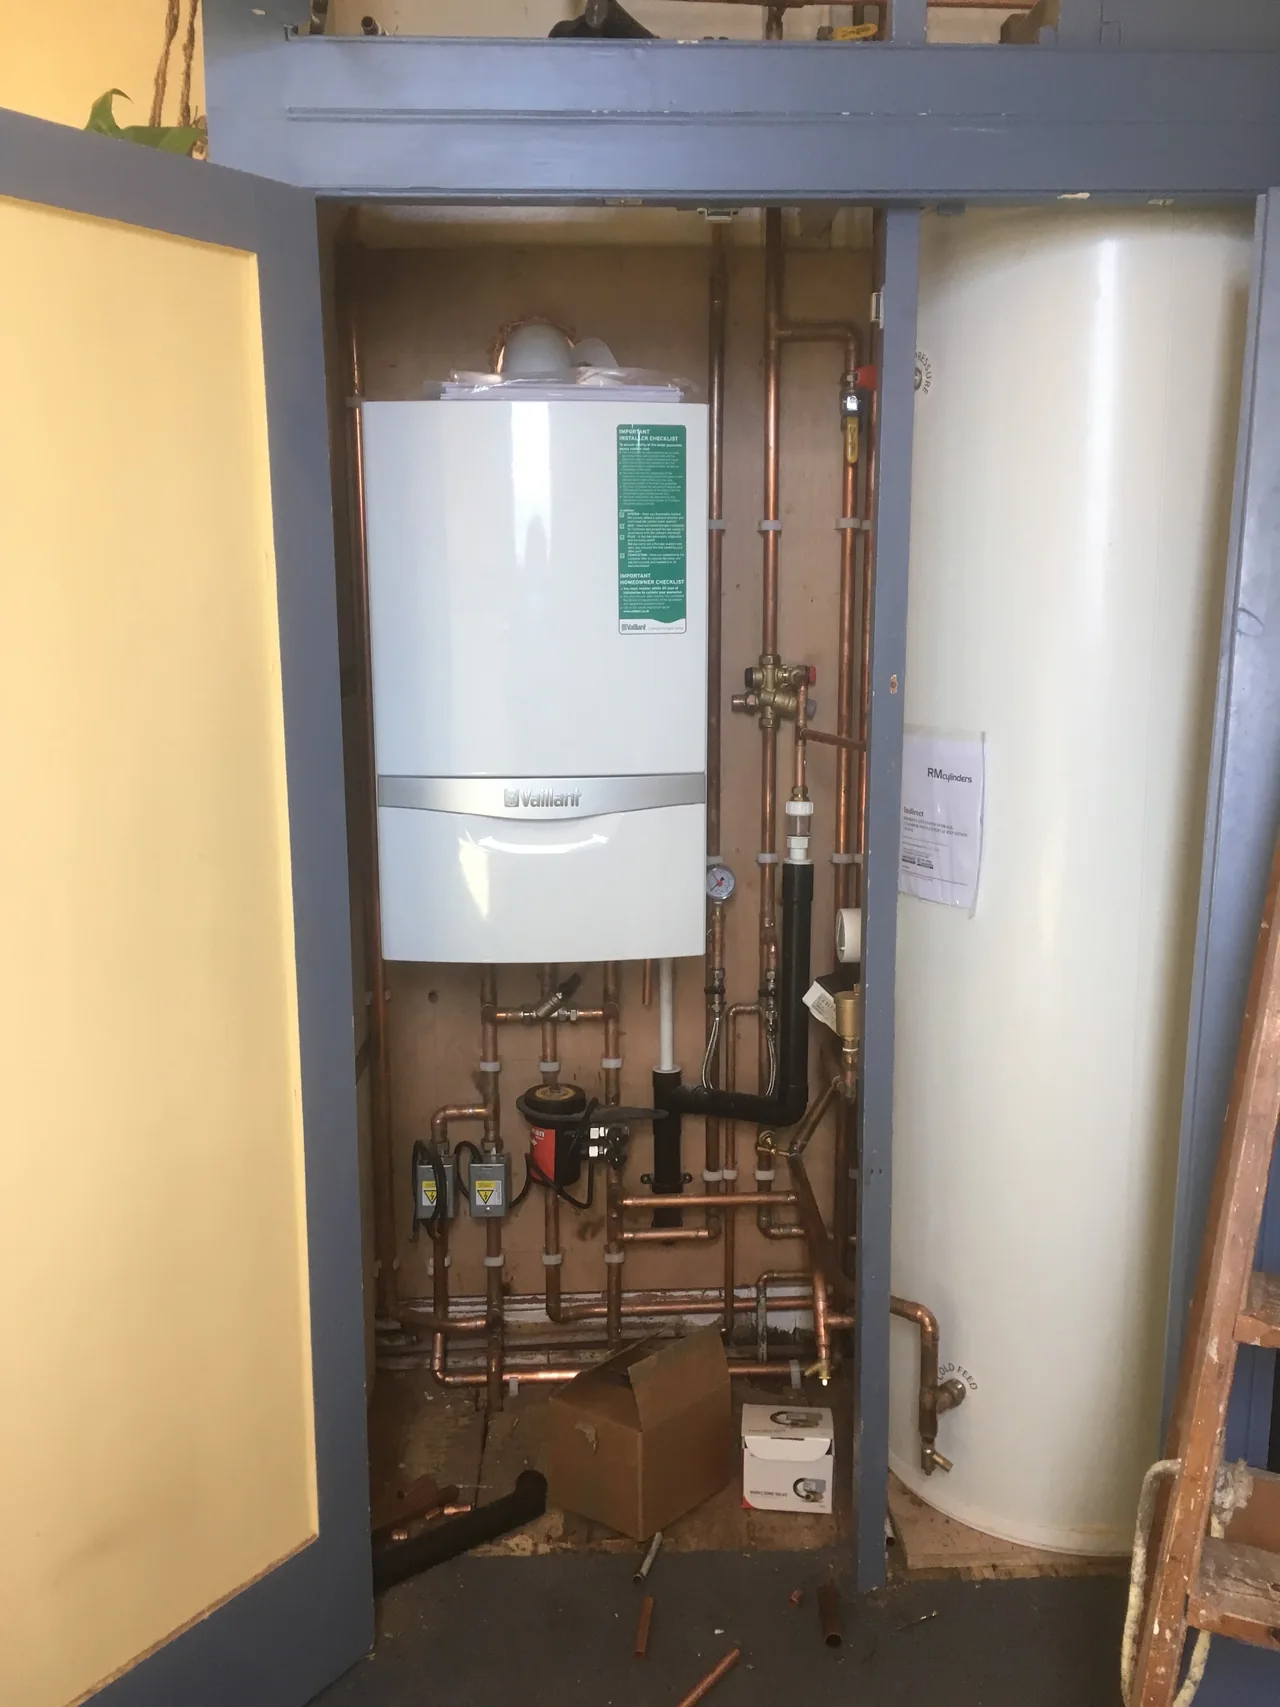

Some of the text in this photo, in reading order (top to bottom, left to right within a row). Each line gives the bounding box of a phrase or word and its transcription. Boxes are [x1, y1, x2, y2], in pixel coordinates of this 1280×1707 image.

[927, 767, 973, 784] RMcylinders
[519, 787, 582, 808] Vaillant
[957, 1366, 978, 1391] FEED
